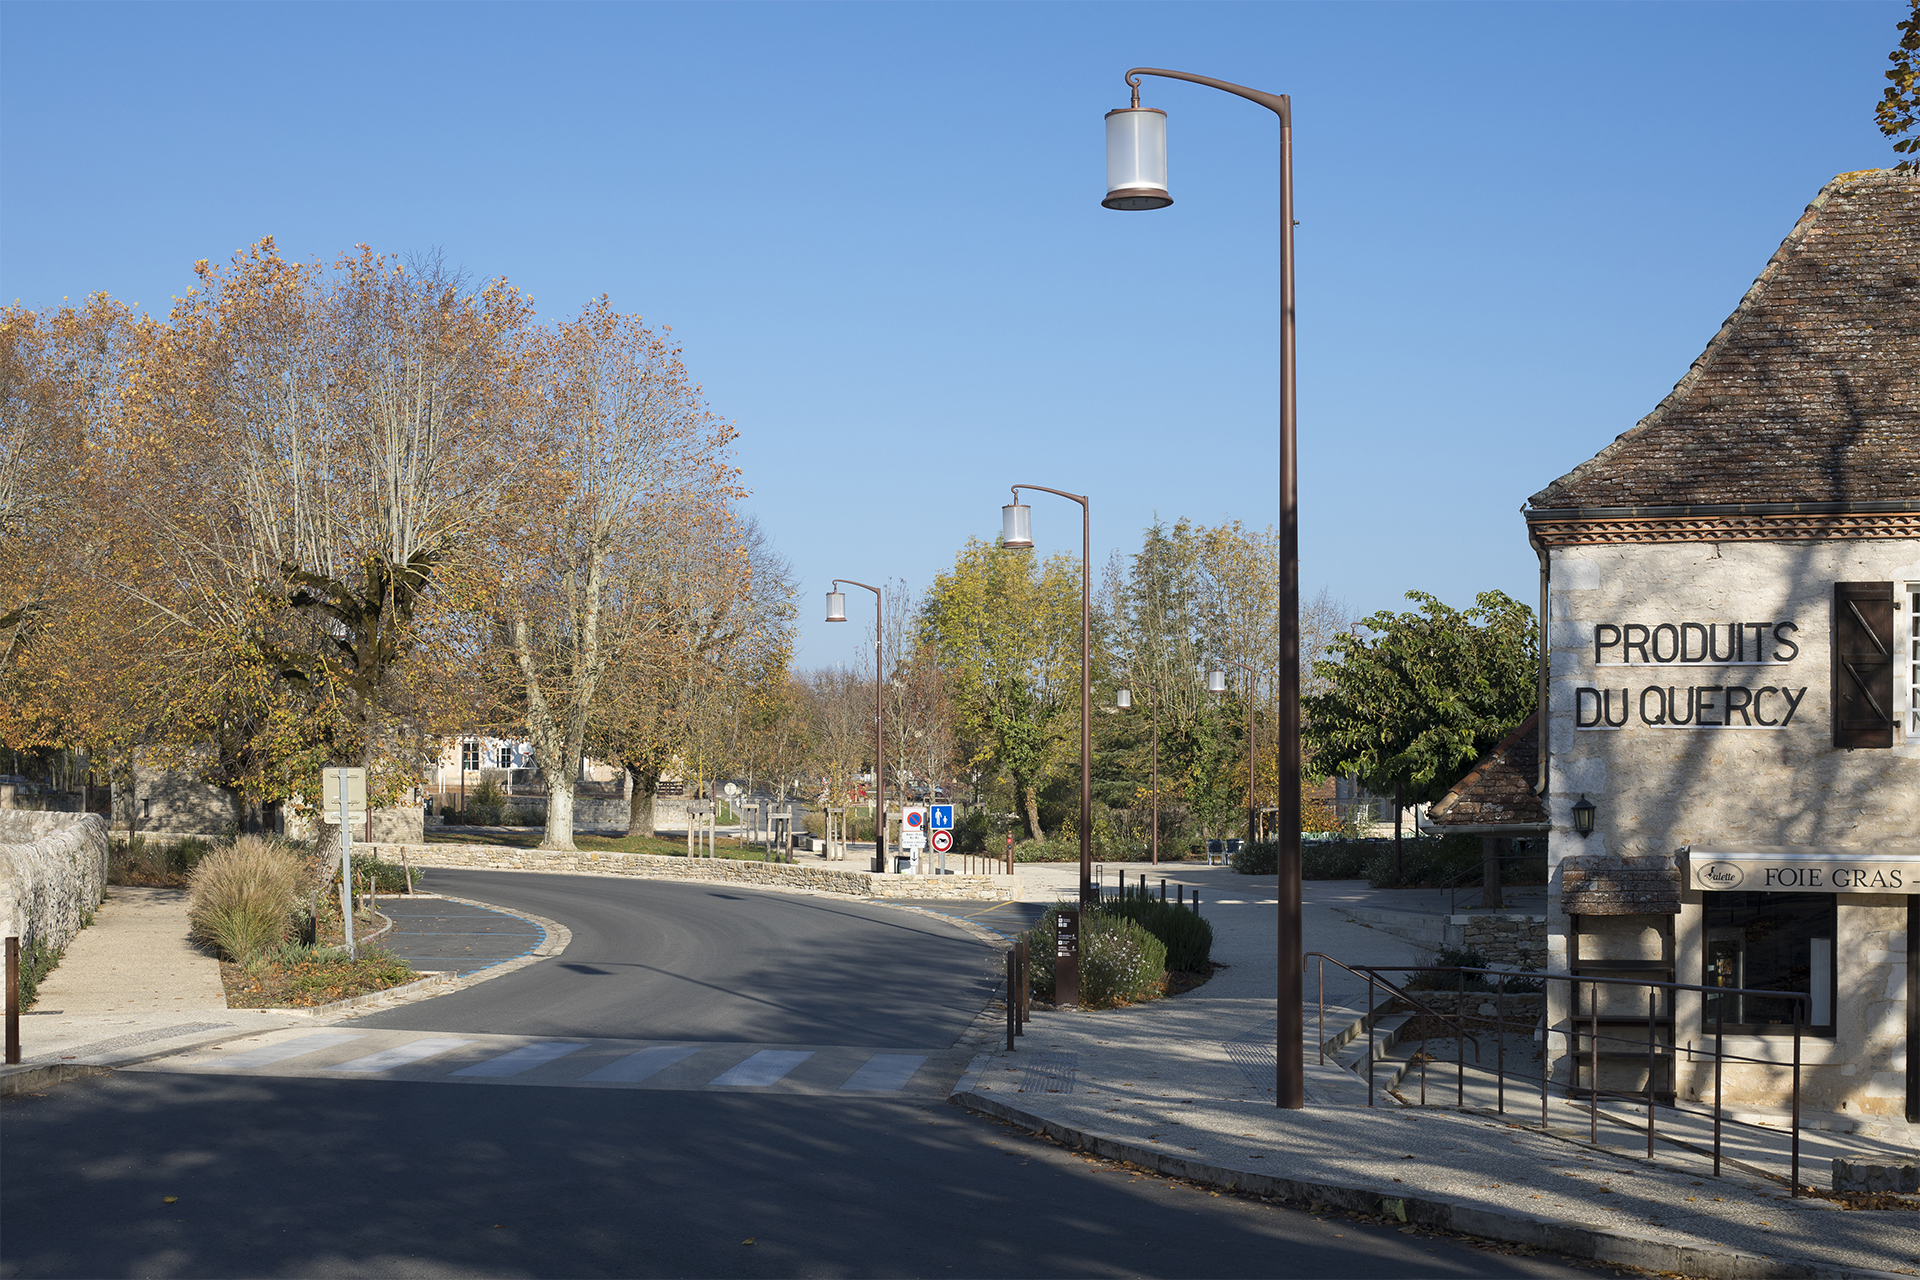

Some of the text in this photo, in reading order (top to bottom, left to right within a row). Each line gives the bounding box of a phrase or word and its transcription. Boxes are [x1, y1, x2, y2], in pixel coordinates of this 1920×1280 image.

[1595, 621, 1799, 664] PRODUITS
[1575, 685, 1808, 728] DU QUERCY
[1764, 867, 1903, 889] FOIE GRAS
